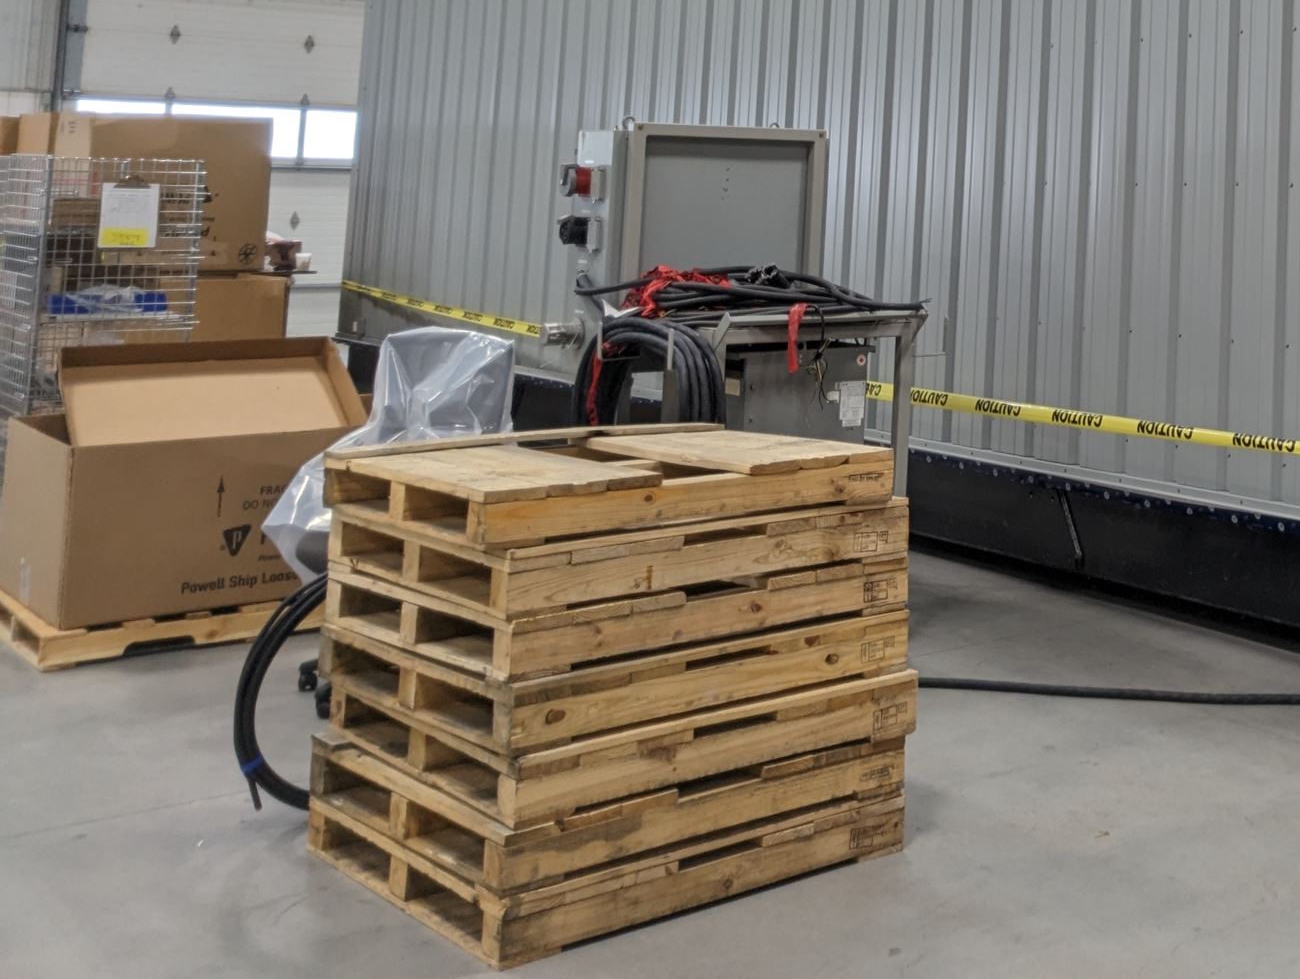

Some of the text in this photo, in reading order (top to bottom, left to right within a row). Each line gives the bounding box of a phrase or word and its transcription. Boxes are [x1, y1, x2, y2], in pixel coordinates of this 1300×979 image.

[975, 399, 1021, 417] CAUTION
[1052, 408, 1103, 428] CAUTION
[1137, 421, 1194, 440] CAUTION
[1232, 432, 1296, 453] CAUTION
[243, 500, 259, 510] DO
[181, 577, 225, 594] Powell
[230, 574, 258, 589] Ship
